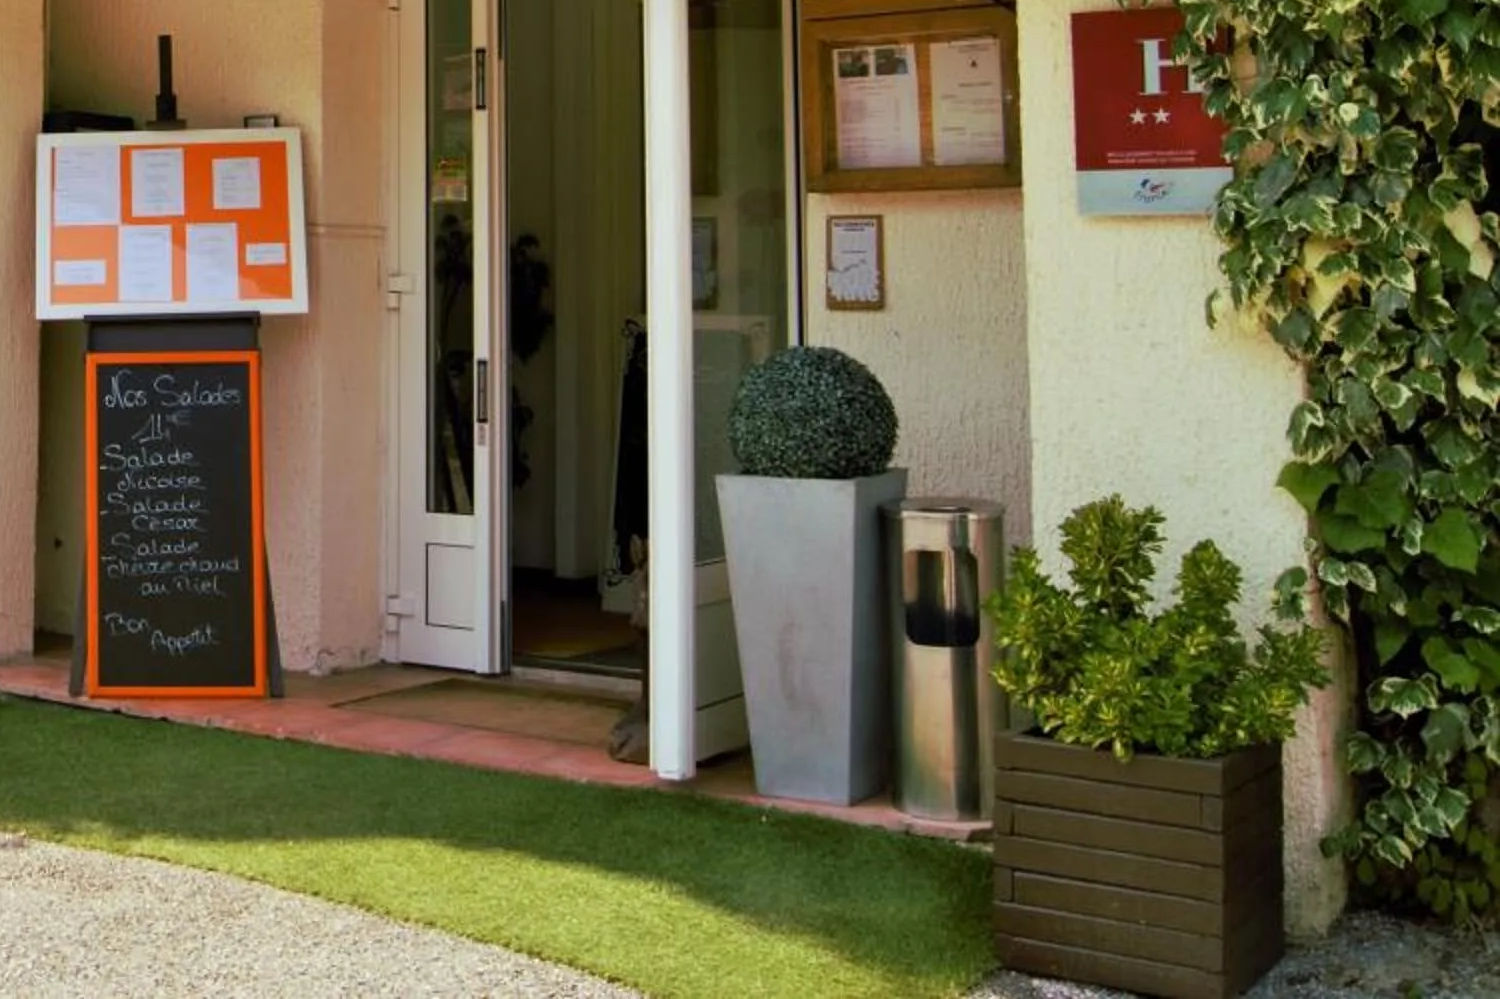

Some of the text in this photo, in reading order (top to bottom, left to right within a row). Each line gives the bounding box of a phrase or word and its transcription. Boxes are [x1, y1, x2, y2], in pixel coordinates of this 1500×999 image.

[104, 369, 242, 409] Nos Salades
[104, 443, 200, 470] Salade
[107, 492, 208, 515] Salade
[111, 532, 199, 557] Salade
[105, 612, 150, 636] Bon
